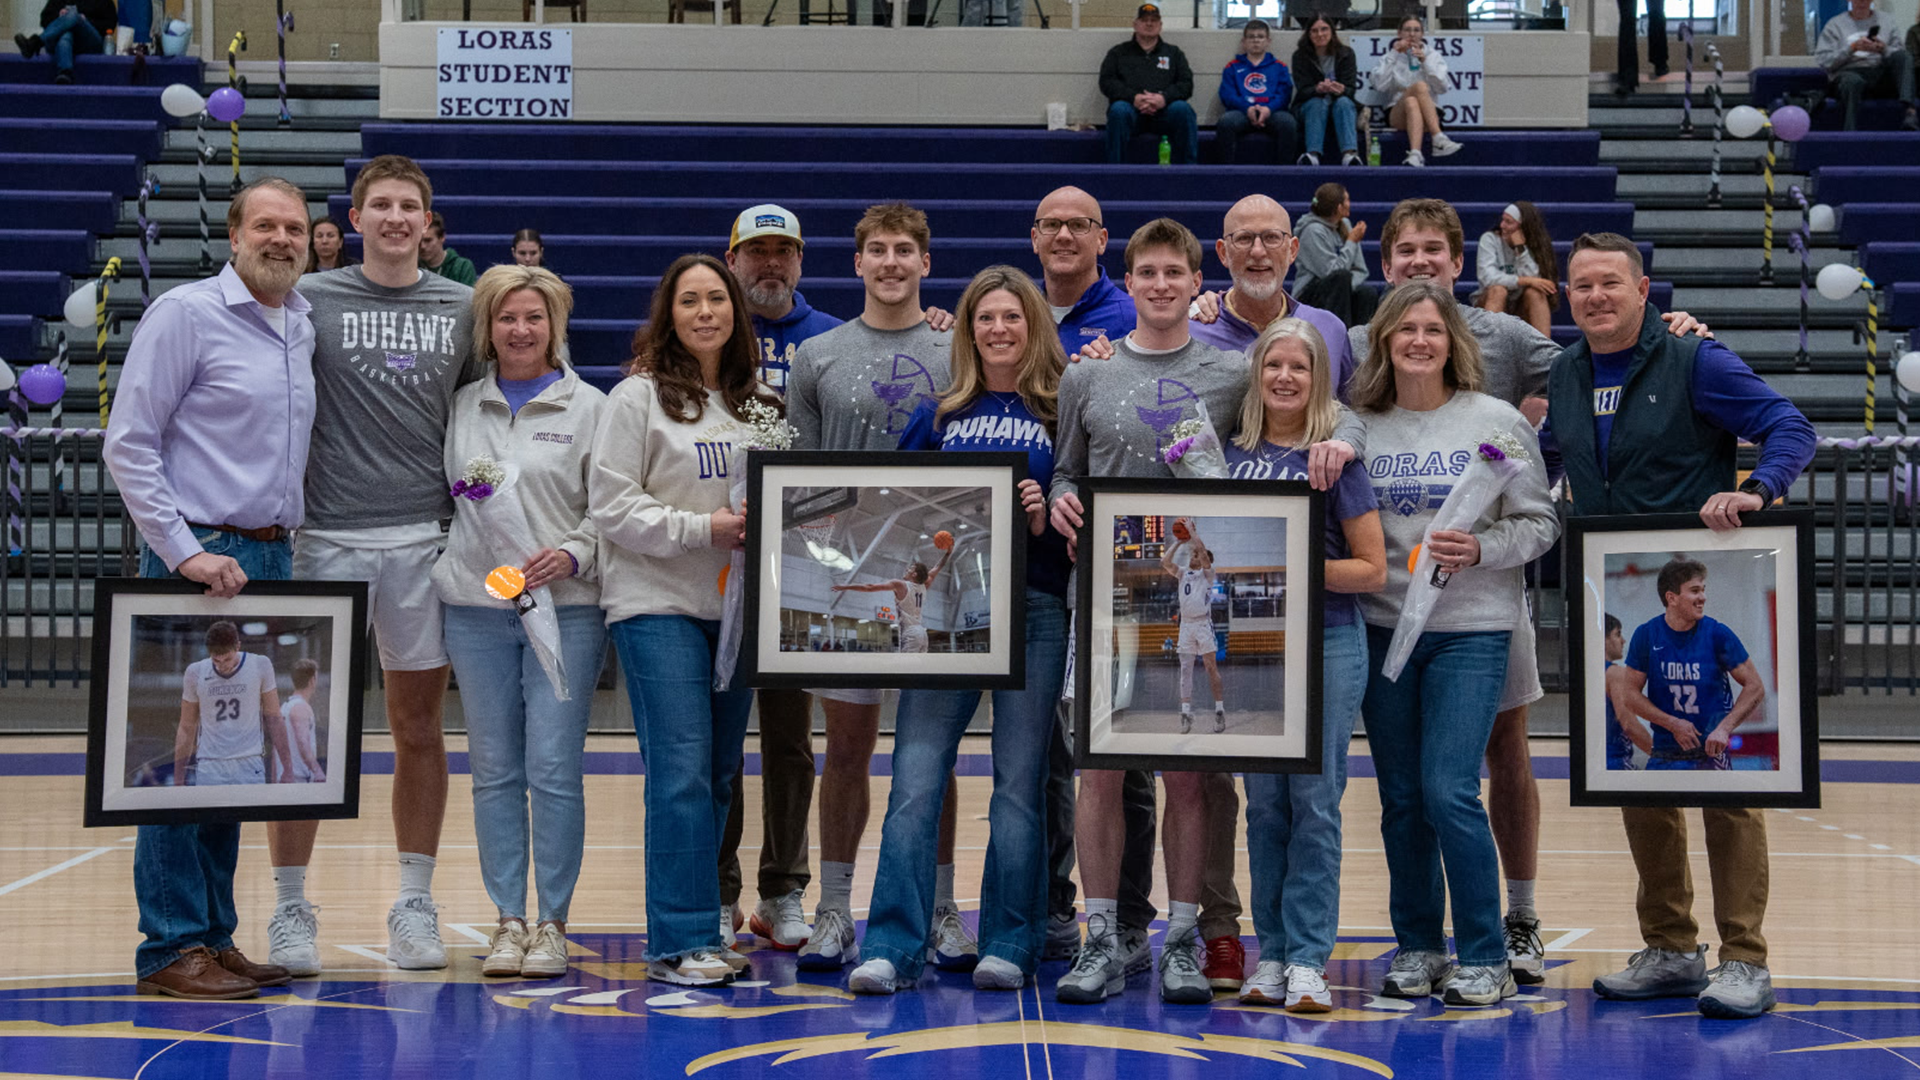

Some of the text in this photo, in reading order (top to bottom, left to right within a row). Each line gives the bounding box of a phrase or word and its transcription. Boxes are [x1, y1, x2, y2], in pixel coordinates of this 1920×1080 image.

[458, 30, 552, 50] LORAS
[1370, 38, 1463, 56] LAS
[439, 64, 571, 84] STUDENT
[440, 97, 570, 117] SECTION
[342, 311, 457, 356] DUHAWK
[350, 355, 449, 386] BASKETBALL
[1369, 450, 1471, 478] ORAS
[1184, 583, 1191, 595] 0
[915, 592, 923, 608] 11
[215, 698, 240, 722] 23
